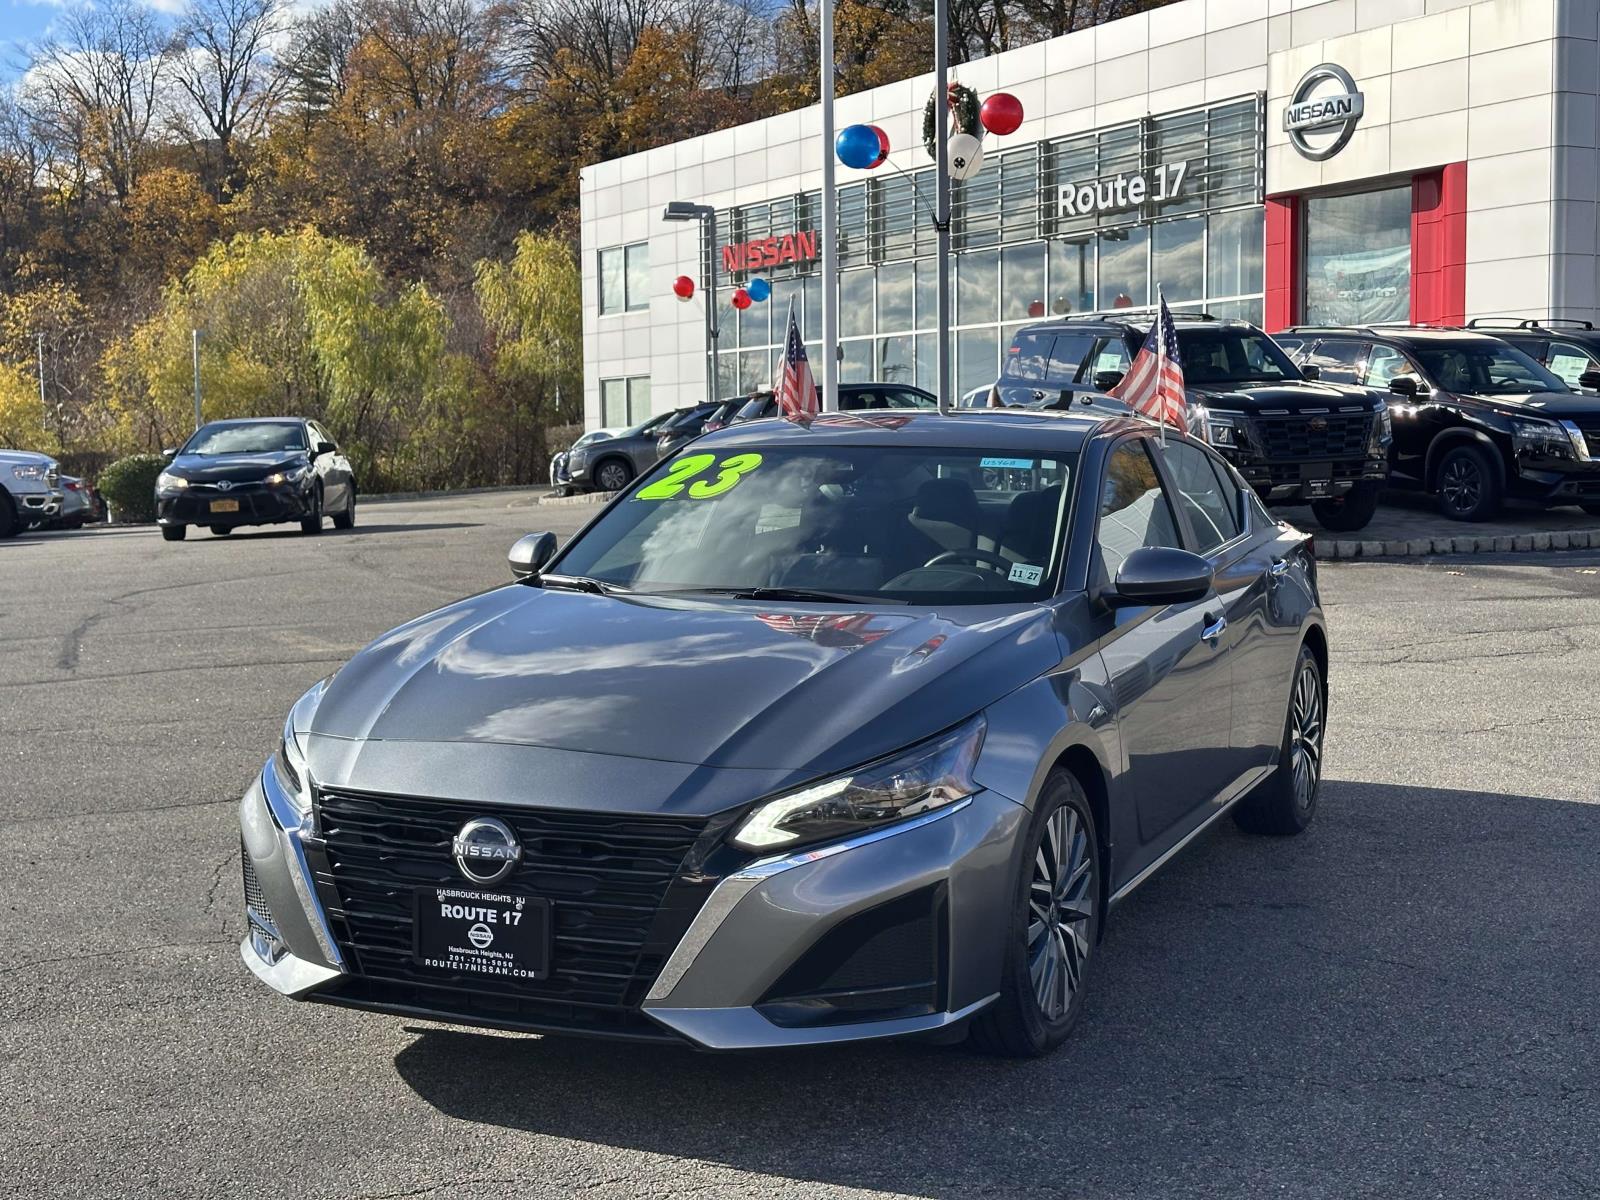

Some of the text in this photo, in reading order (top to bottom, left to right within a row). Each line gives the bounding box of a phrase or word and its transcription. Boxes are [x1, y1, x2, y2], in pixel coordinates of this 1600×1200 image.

[1287, 98, 1352, 125] NISSAN
[1057, 161, 1187, 217] Route 17
[722, 229, 817, 273] NISSAN
[635, 453, 763, 500] 23
[1012, 569, 1039, 580] 11 27
[453, 844, 519, 859] NISSAN
[436, 888, 480, 900] HASBROUCK
[516, 896, 526, 905] NJ
[441, 903, 522, 926] ROUTE 17
[448, 945, 479, 955] Hasbrouck
[505, 952, 514, 960] NJ
[425, 958, 535, 979] ROUTE17NISSAN.COM
